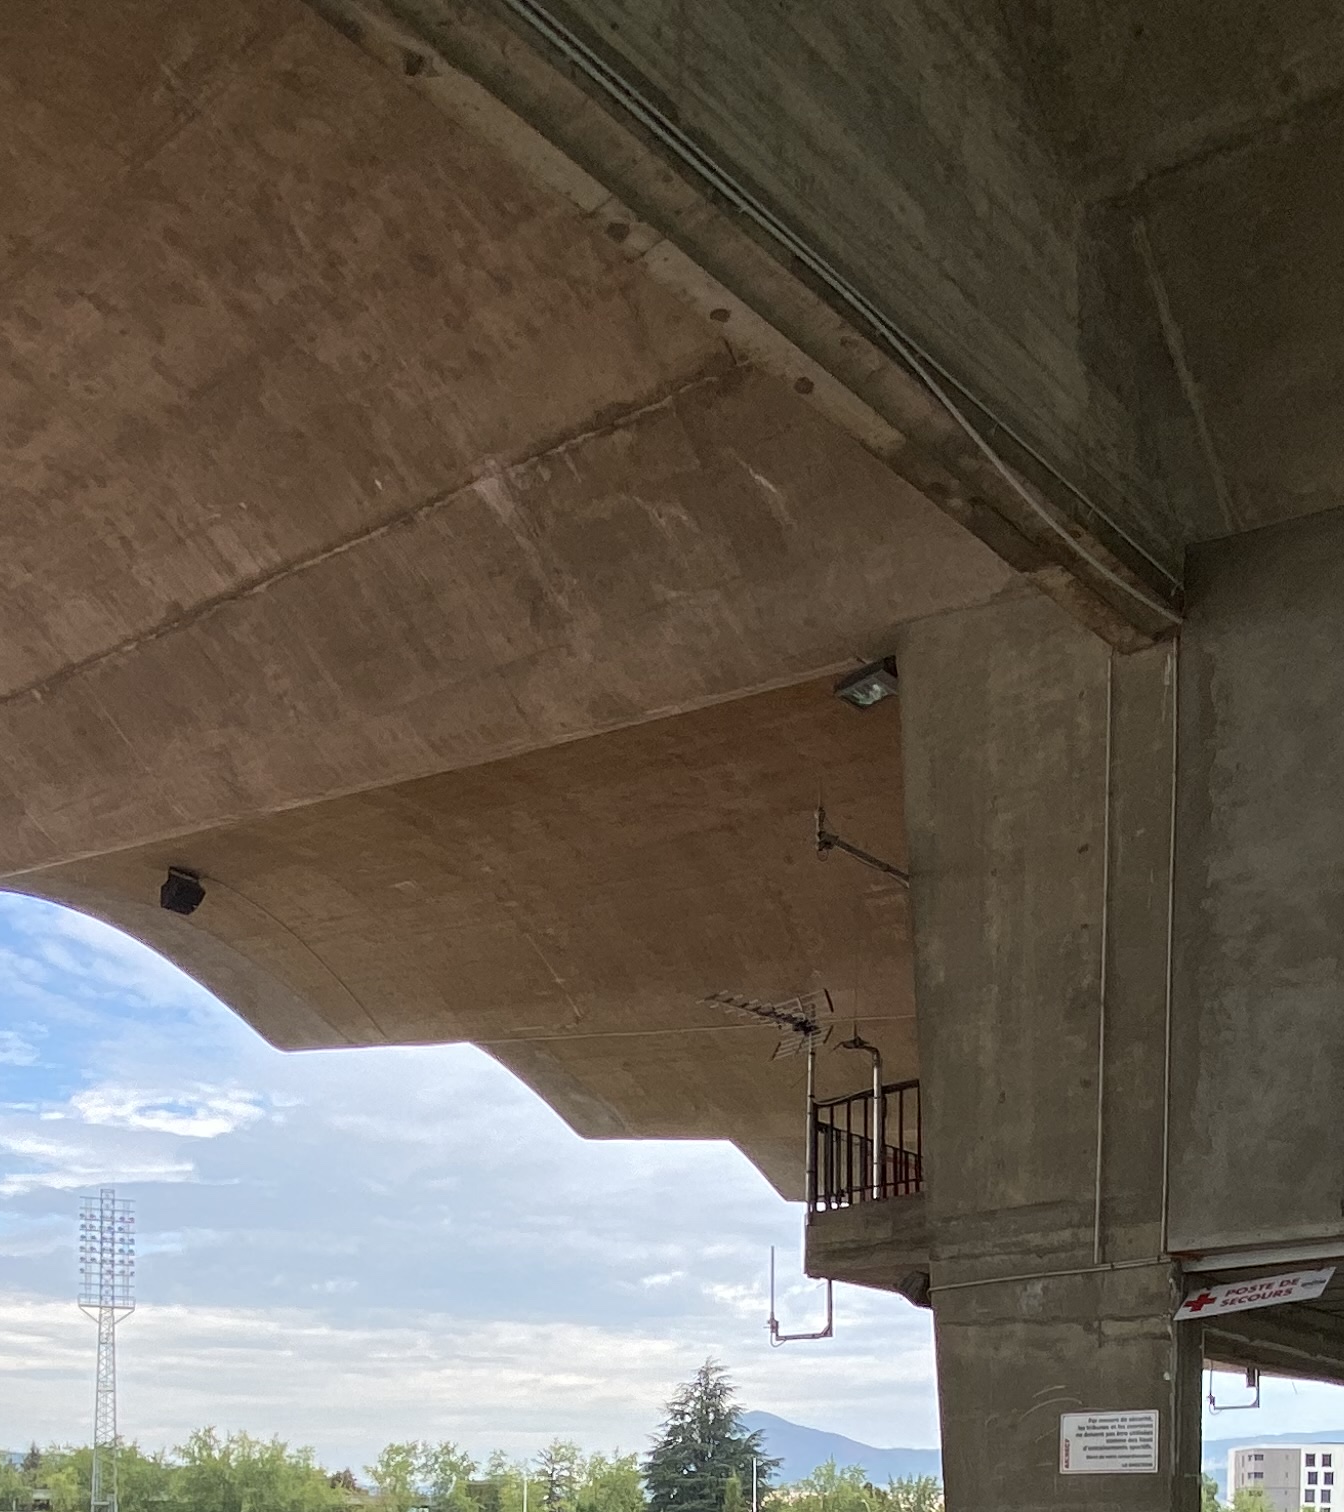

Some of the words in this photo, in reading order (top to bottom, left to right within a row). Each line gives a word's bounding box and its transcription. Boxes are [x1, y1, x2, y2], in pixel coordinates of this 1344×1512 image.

[1220, 1287, 1293, 1307] SECOURS
[1225, 1282, 1276, 1297] POSTE
[1278, 1277, 1301, 1287] DE
